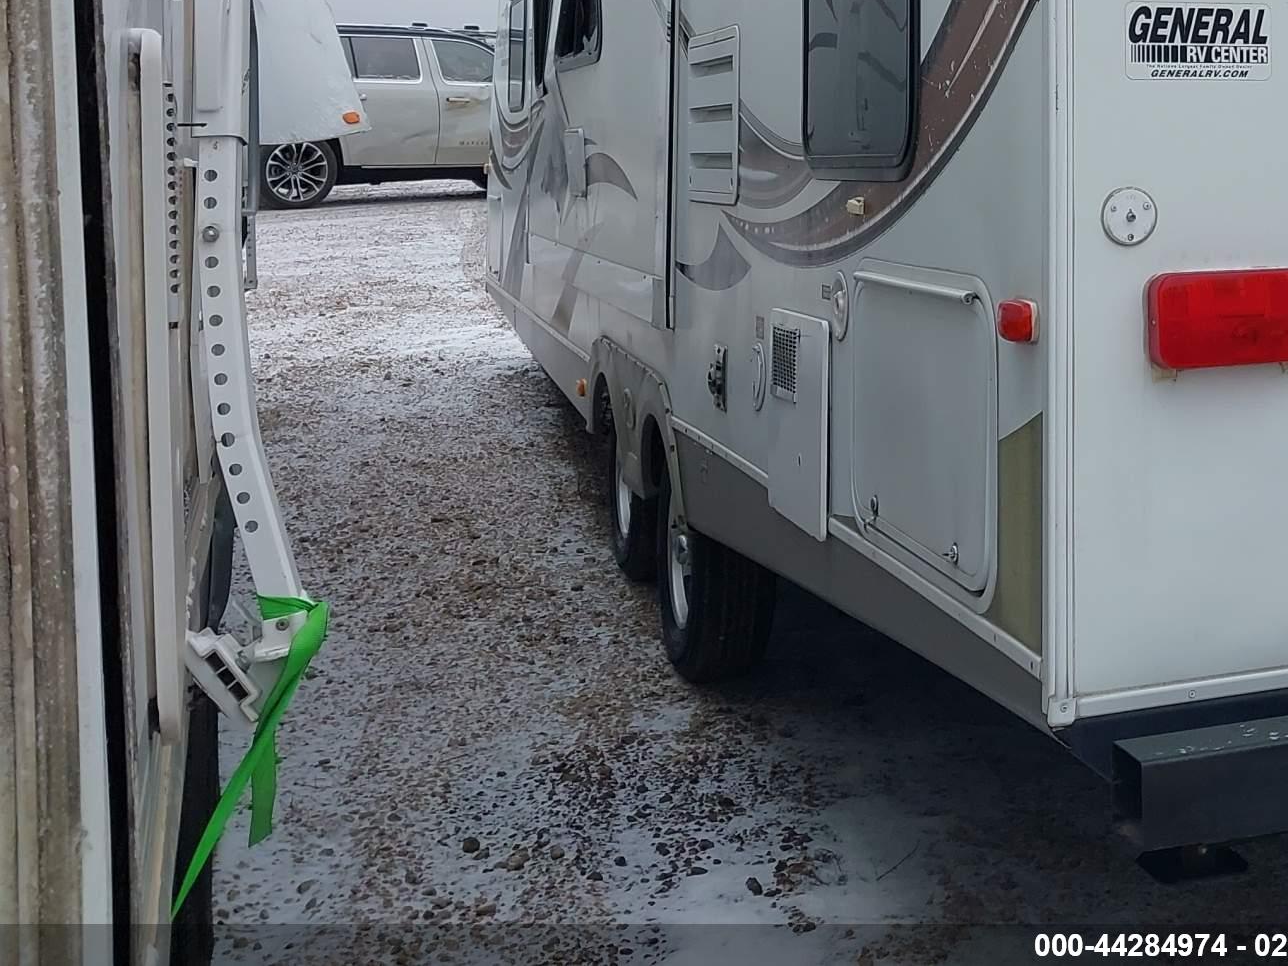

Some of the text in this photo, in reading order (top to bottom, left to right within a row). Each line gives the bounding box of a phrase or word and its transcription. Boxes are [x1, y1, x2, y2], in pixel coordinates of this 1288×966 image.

[1128, 6, 1268, 44] GENERAL
[1187, 46, 1268, 63] RV CENTER
[1150, 69, 1249, 78] GENERALRV.COM
